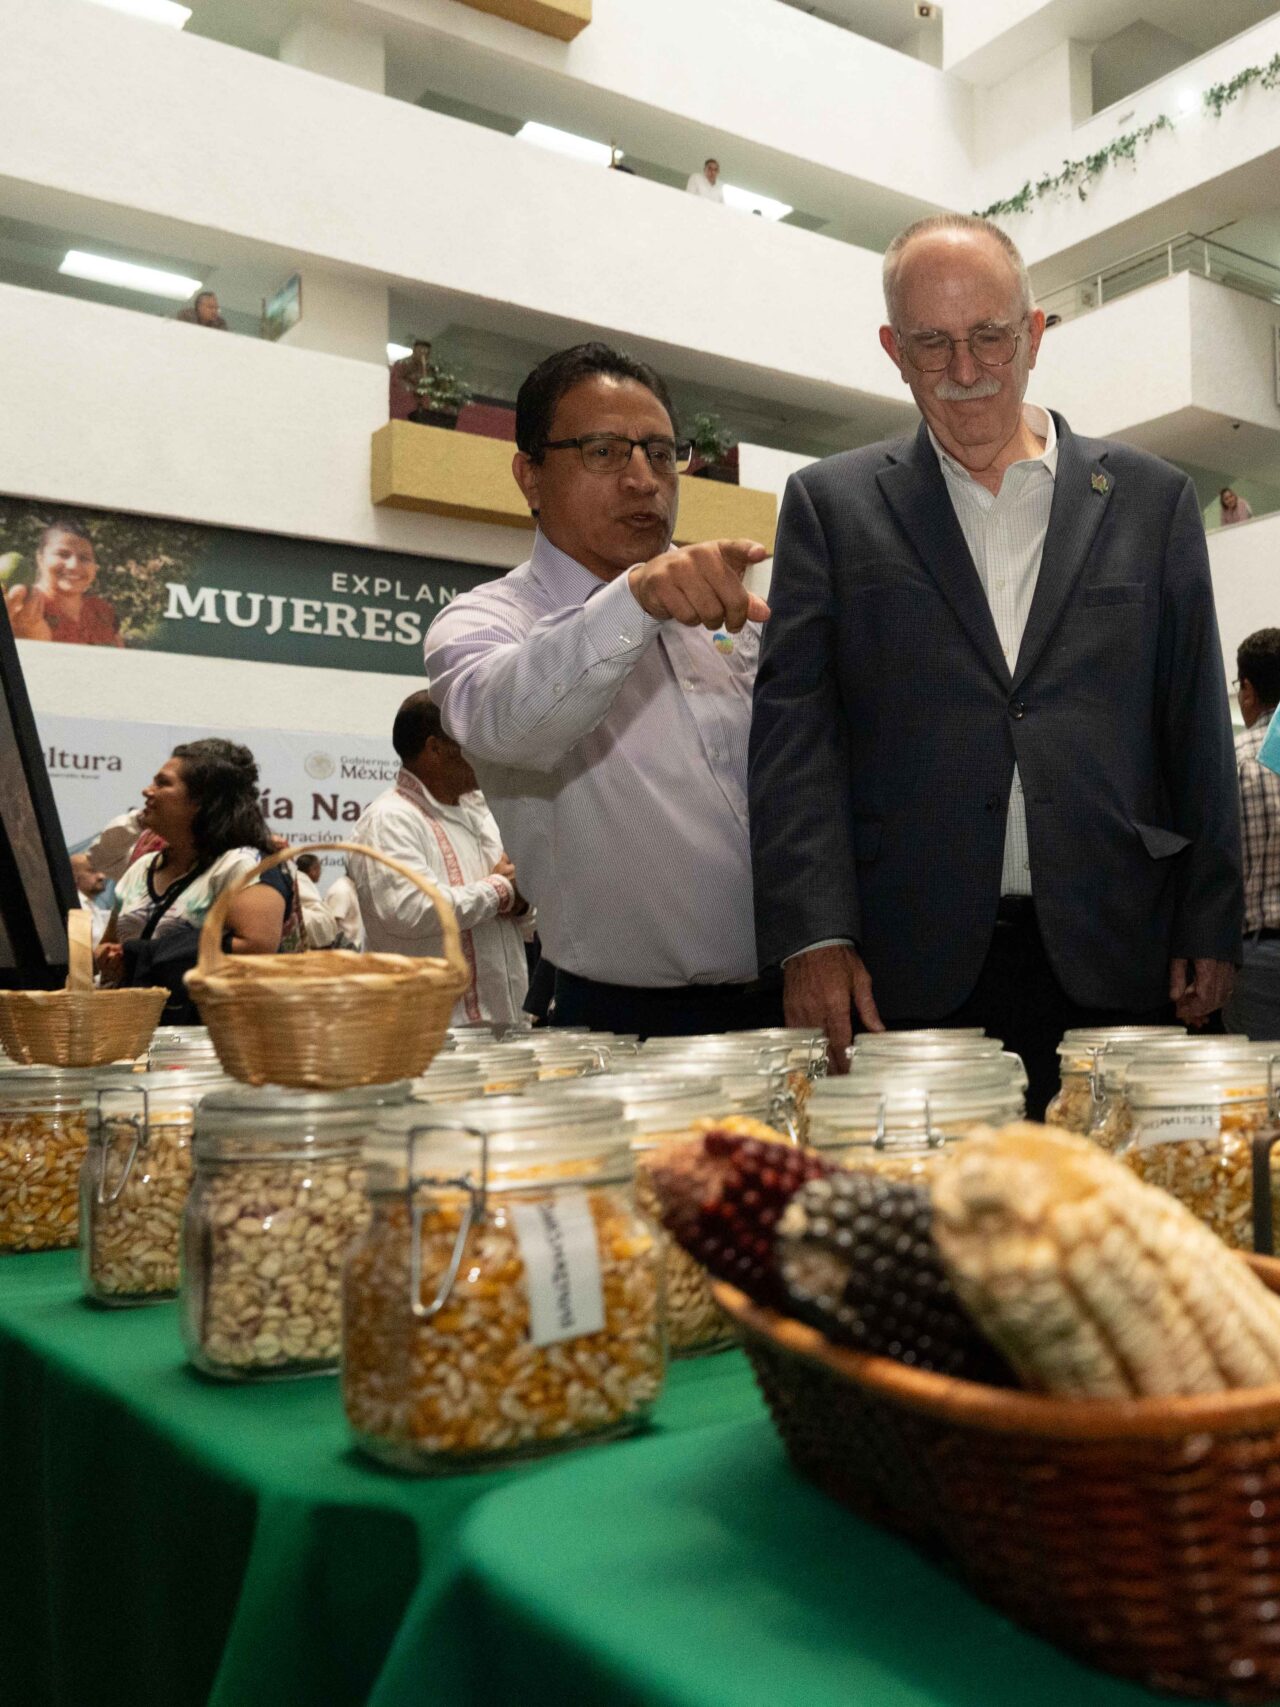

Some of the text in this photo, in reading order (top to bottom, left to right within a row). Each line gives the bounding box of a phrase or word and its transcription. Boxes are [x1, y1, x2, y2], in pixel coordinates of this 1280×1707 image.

[331, 572, 457, 605] EXPLAN
[163, 582, 422, 646] MUJERES
[42, 746, 123, 772] ltura
